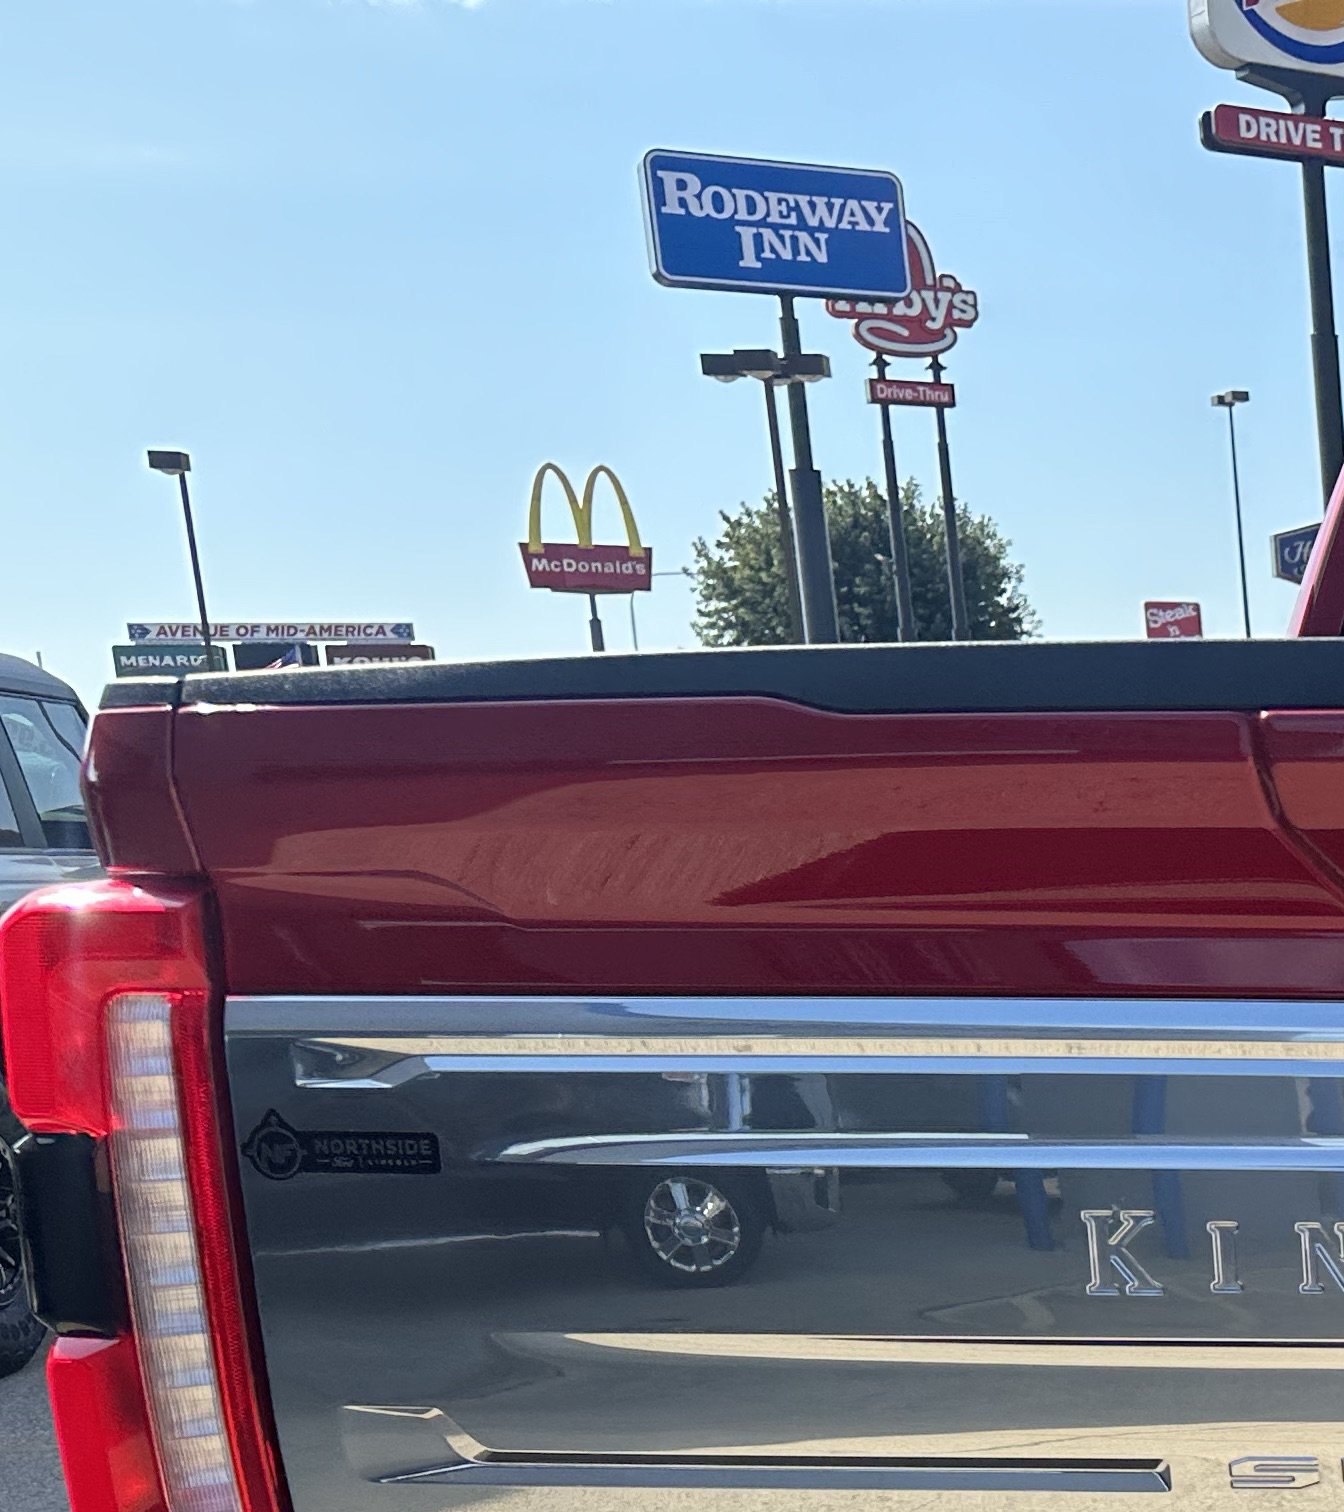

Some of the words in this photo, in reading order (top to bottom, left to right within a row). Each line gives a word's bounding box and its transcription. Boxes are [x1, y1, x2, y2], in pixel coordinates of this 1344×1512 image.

[1238, 113, 1322, 148] DRIVE
[657, 169, 894, 233] RODEWAY
[734, 226, 829, 269] INN
[876, 384, 950, 404] Drive-Thru
[531, 557, 646, 576] McDonald's
[1146, 604, 1198, 628] Steak
[156, 625, 228, 638] AVENUE
[235, 625, 260, 638] OF
[266, 625, 387, 638] MID-AMERICA
[313, 1138, 433, 1155] NORTHSIDE
